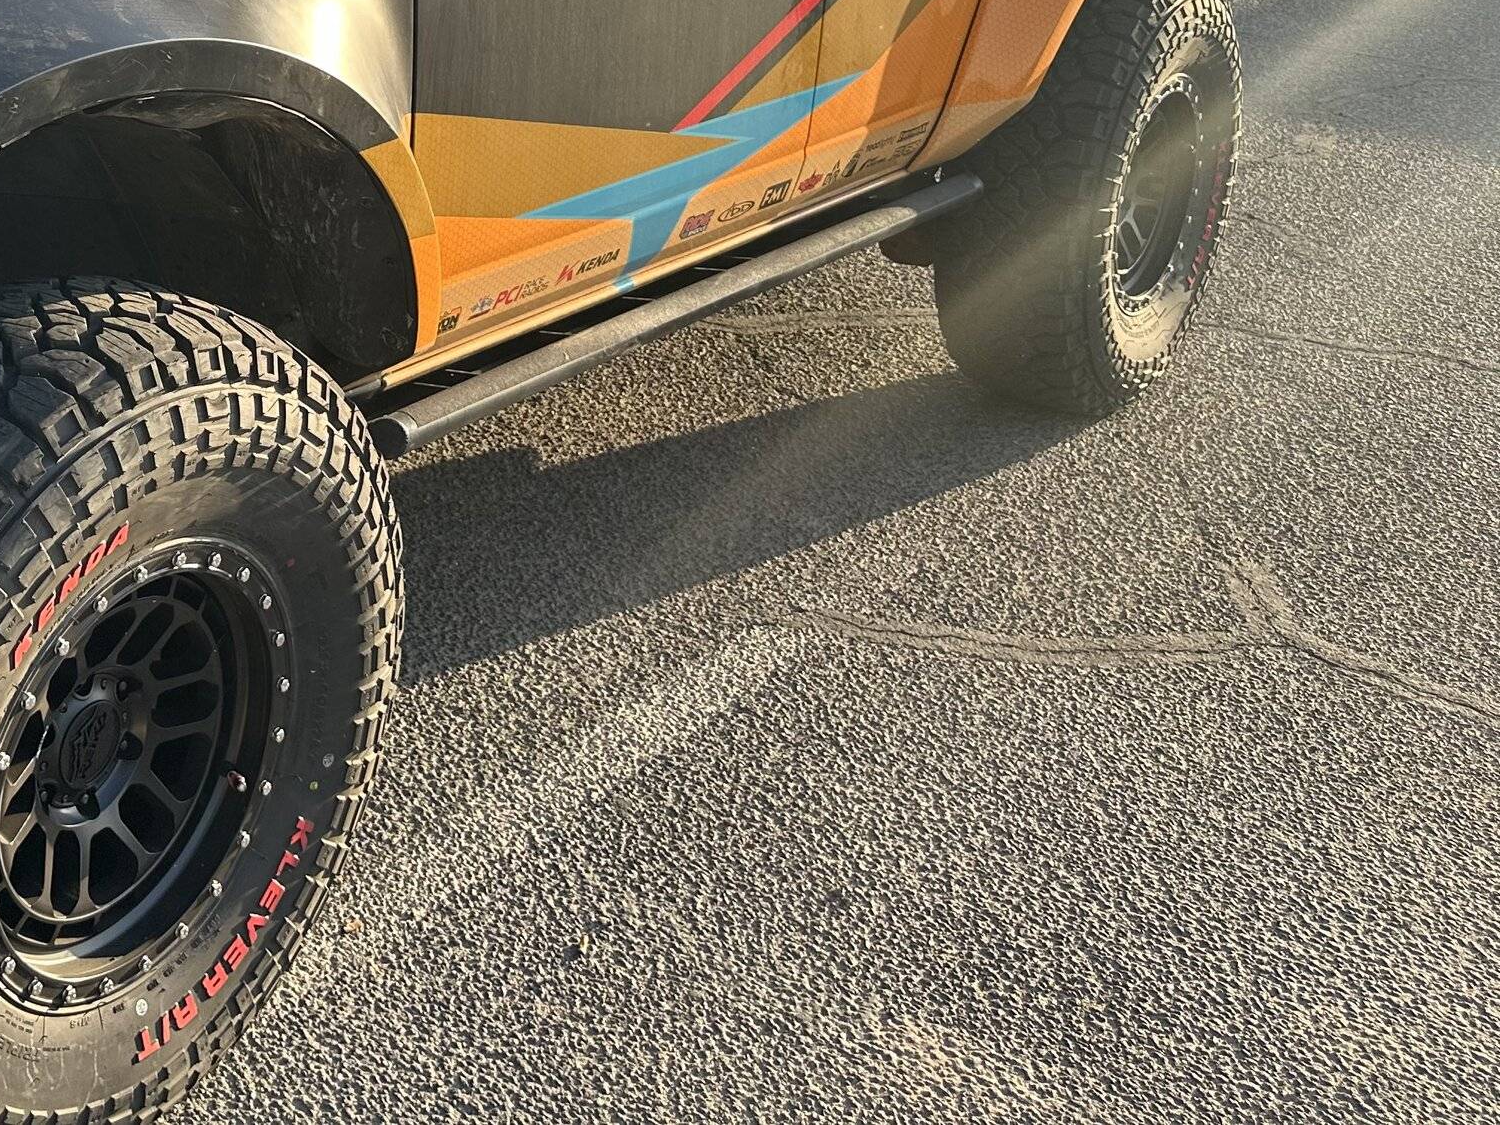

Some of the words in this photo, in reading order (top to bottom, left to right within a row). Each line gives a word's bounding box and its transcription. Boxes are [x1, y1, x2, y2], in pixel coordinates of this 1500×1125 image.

[761, 181, 790, 207] FMI
[576, 248, 620, 275] KENDA
[492, 283, 524, 309] PCI
[12, 520, 130, 670] KENDA
[201, 815, 315, 998] KLEVER
[136, 989, 198, 1063] R/T
